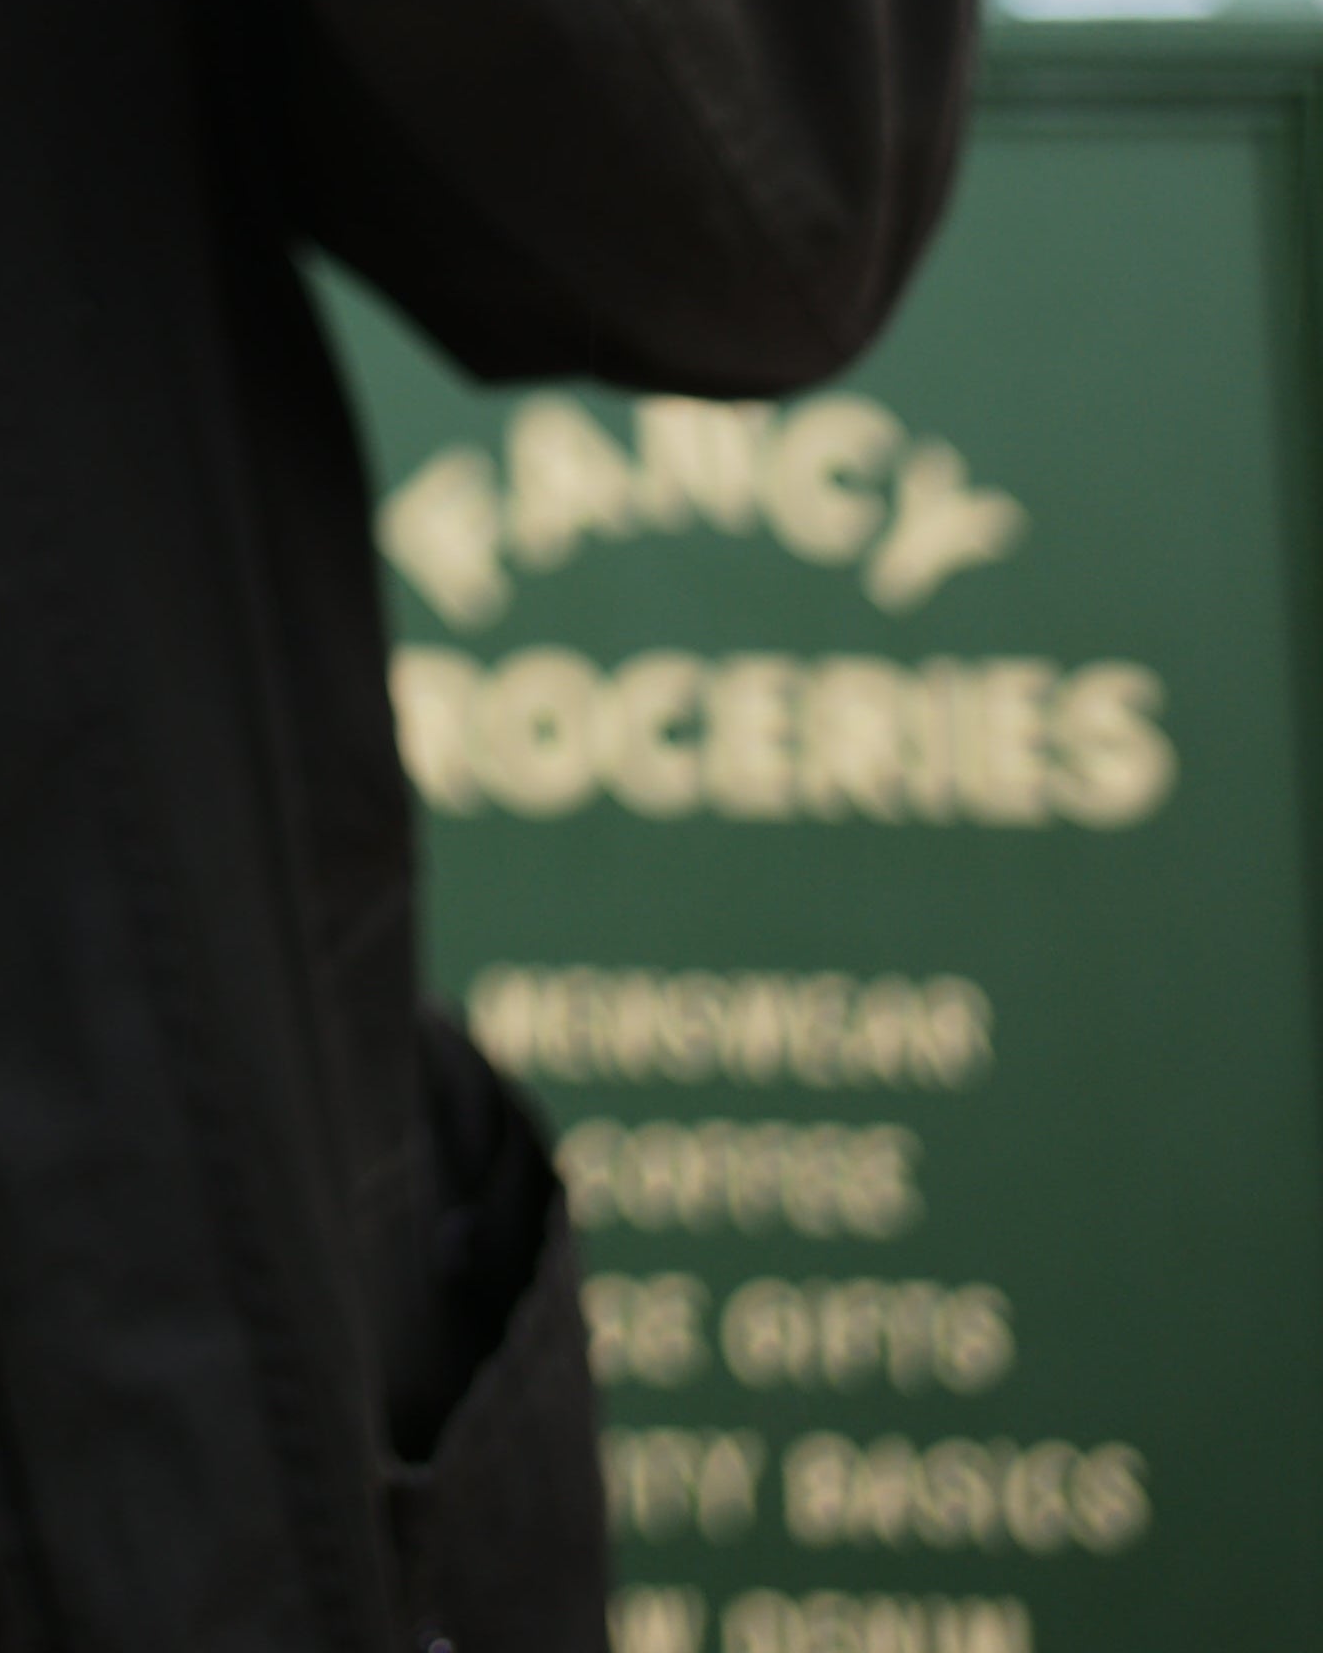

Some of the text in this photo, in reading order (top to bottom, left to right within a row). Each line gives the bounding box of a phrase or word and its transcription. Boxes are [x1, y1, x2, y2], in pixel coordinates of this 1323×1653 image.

[379, 393, 1023, 625] FANCY
[389, 645, 1173, 827] ROCERIES
[721, 1281, 1012, 1392] GIFTS
[785, 1434, 1150, 1553] BASICS
